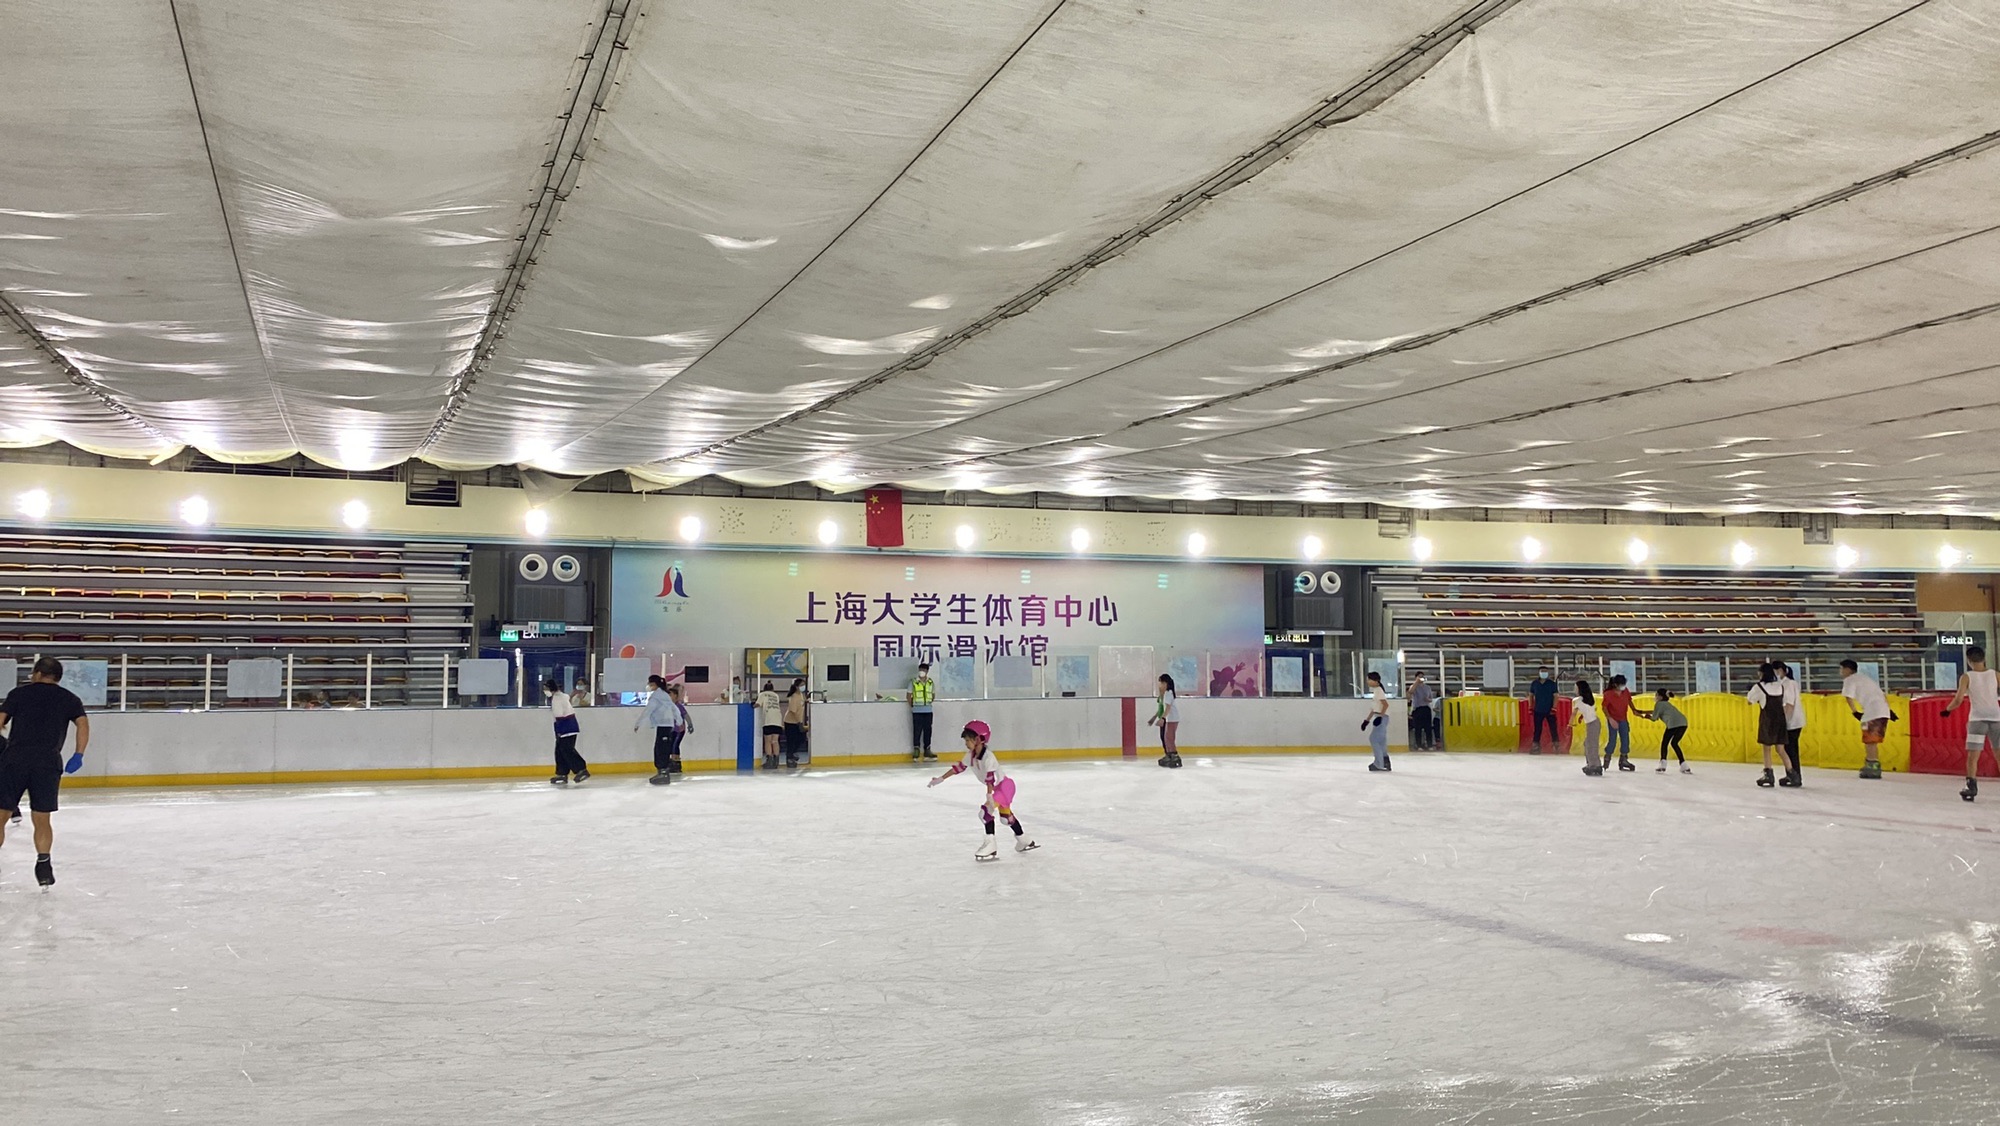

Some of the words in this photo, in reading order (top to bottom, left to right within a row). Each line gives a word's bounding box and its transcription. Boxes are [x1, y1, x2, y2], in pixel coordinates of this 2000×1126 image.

[796, 591, 1118, 627] 上海大学生体育中心
[872, 634, 1049, 668] 国际滑冰馆
